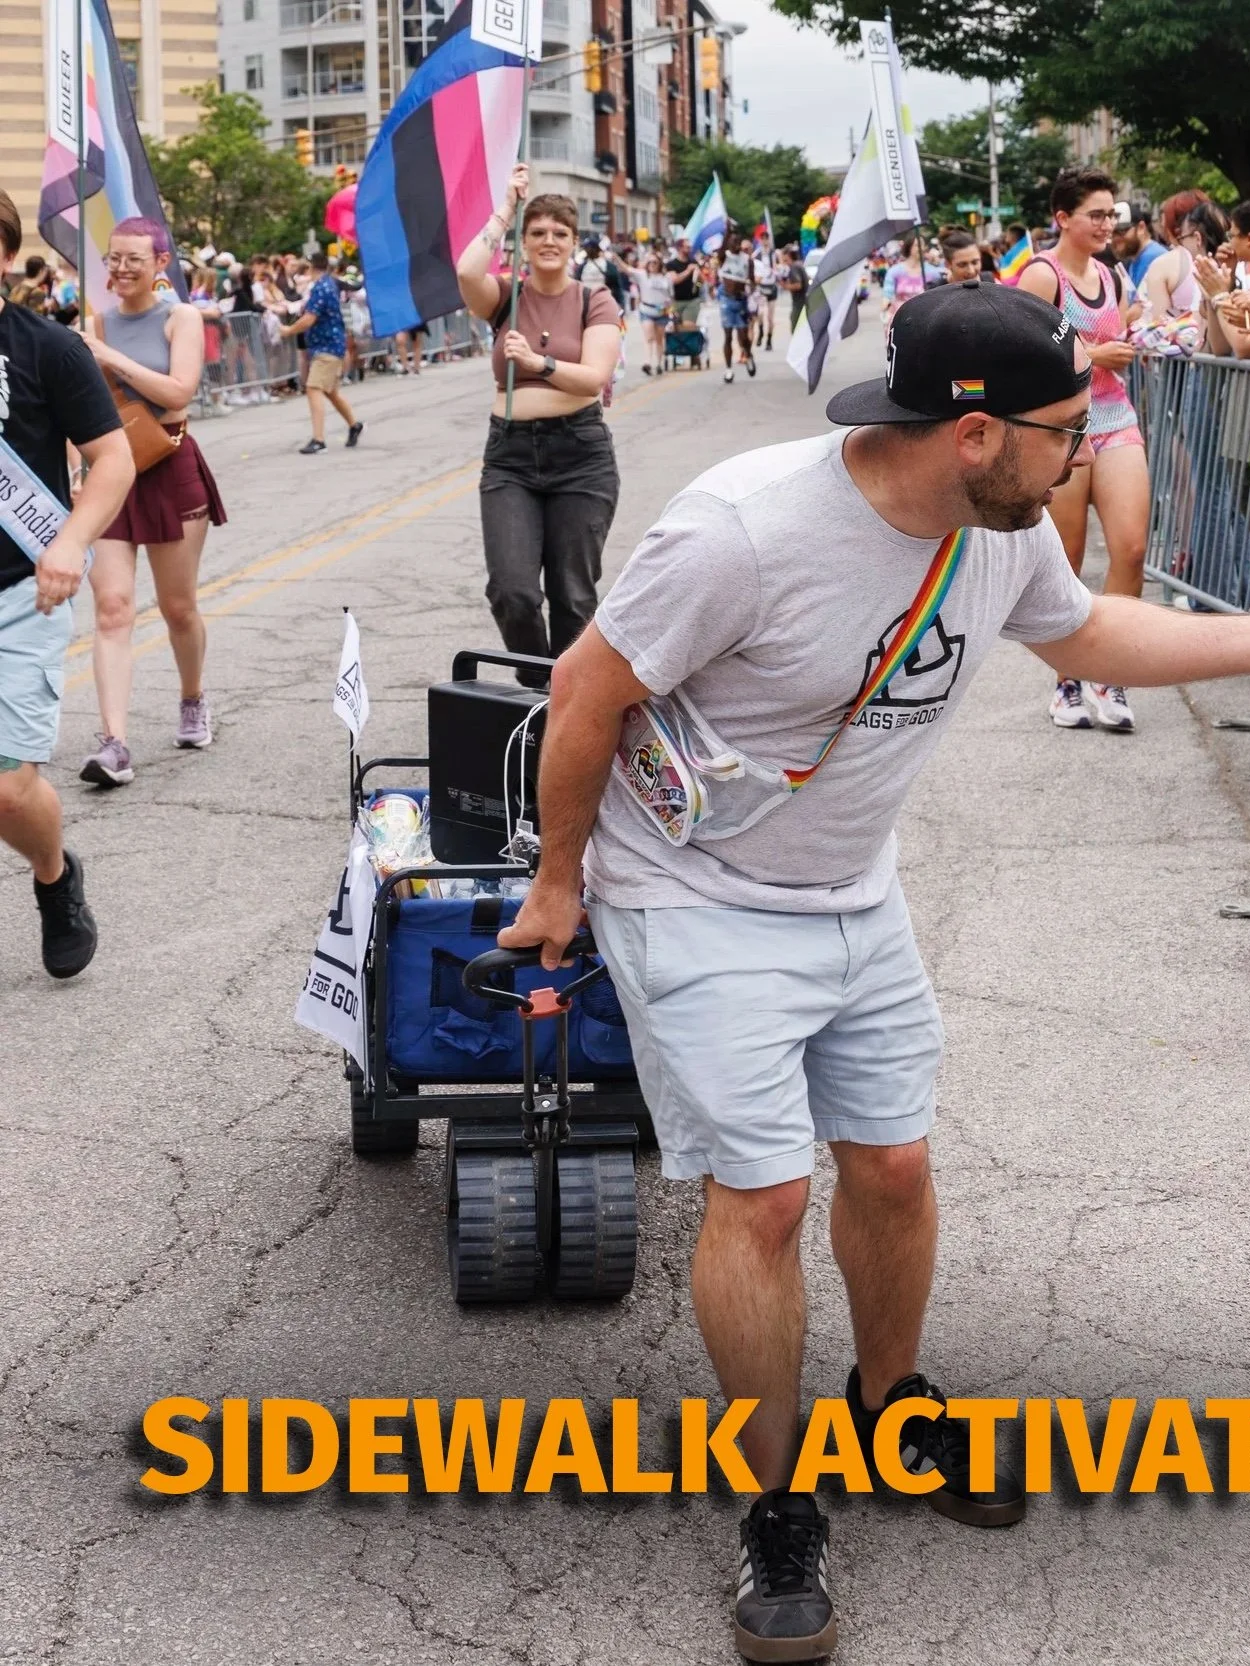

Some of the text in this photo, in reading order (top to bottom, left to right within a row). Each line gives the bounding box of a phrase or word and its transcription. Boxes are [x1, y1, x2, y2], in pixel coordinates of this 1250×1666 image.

[60, 49, 72, 126] QUEER
[885, 128, 905, 203] AGENDER
[0, 468, 18, 502] ns
[838, 710, 893, 730] FAGS
[311, 978, 331, 996] FOR
[331, 982, 359, 1022] GOO
